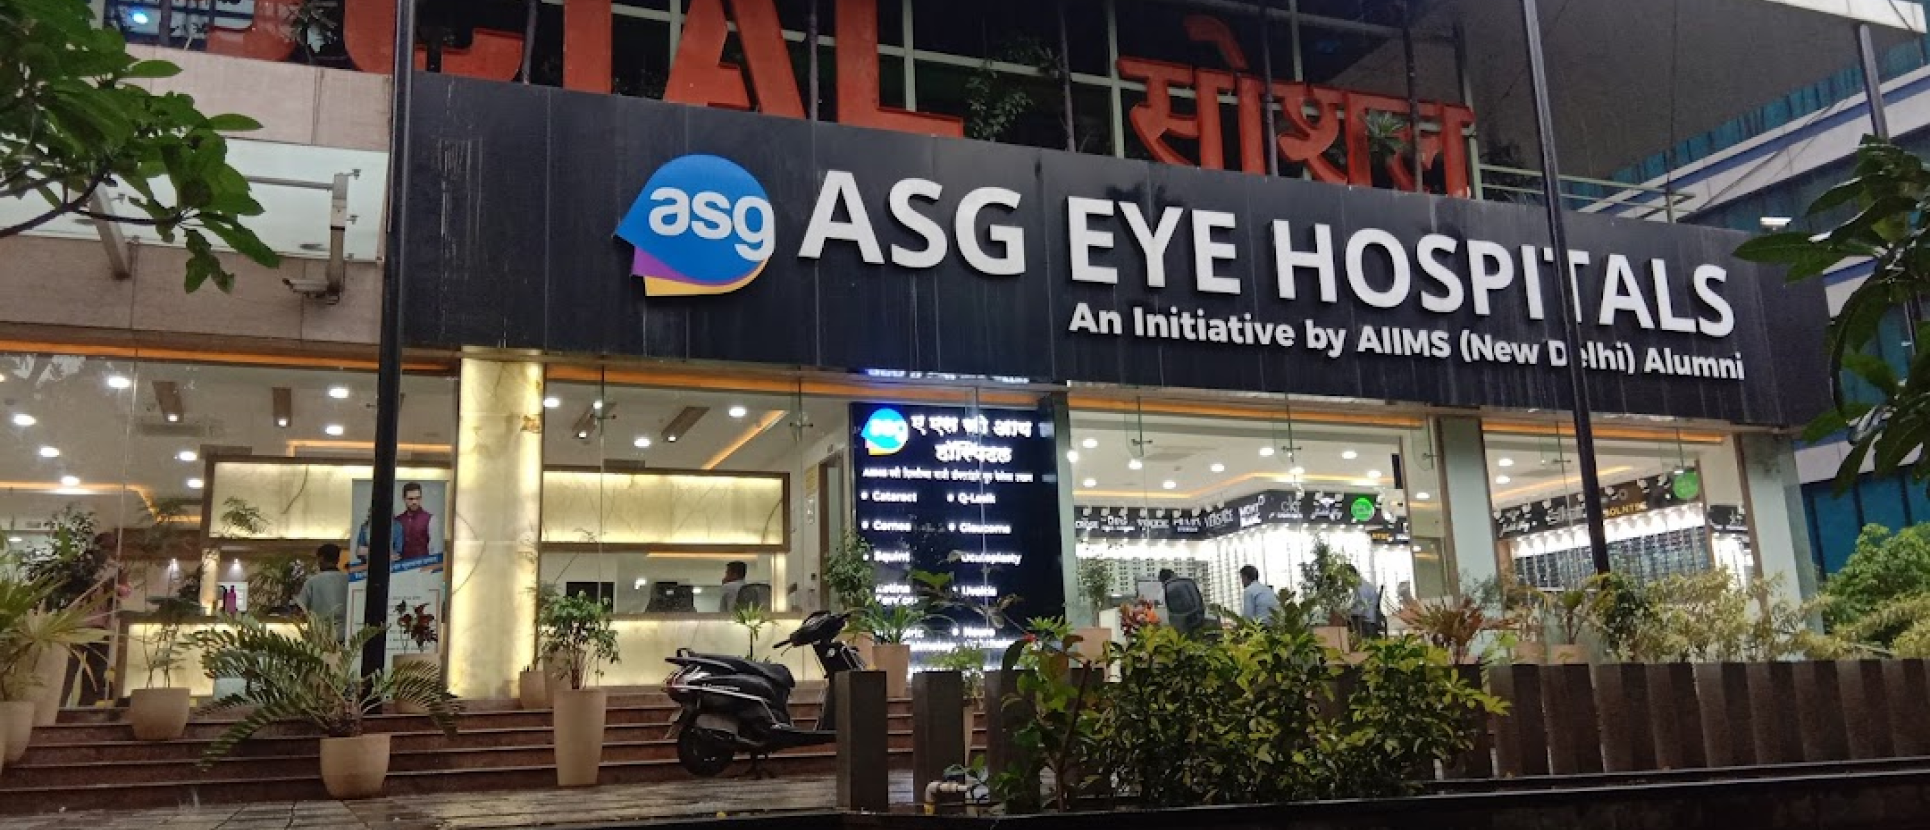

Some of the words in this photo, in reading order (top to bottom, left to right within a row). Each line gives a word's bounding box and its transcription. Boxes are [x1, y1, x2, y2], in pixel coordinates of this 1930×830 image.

[651, 188, 775, 262] asg
[799, 171, 1025, 275] ASG
[1069, 196, 1241, 294] EYE
[1273, 219, 1735, 337] HOSPITALS
[1069, 302, 1123, 335] An
[1133, 306, 1295, 347] Initiative
[1305, 319, 1346, 358] by
[1357, 326, 1452, 358] AIIMS
[1459, 330, 1540, 366] (New
[1547, 339, 1636, 374] Delhi)
[1643, 348, 1746, 379] Alumni
[872, 490, 918, 503] Cataract
